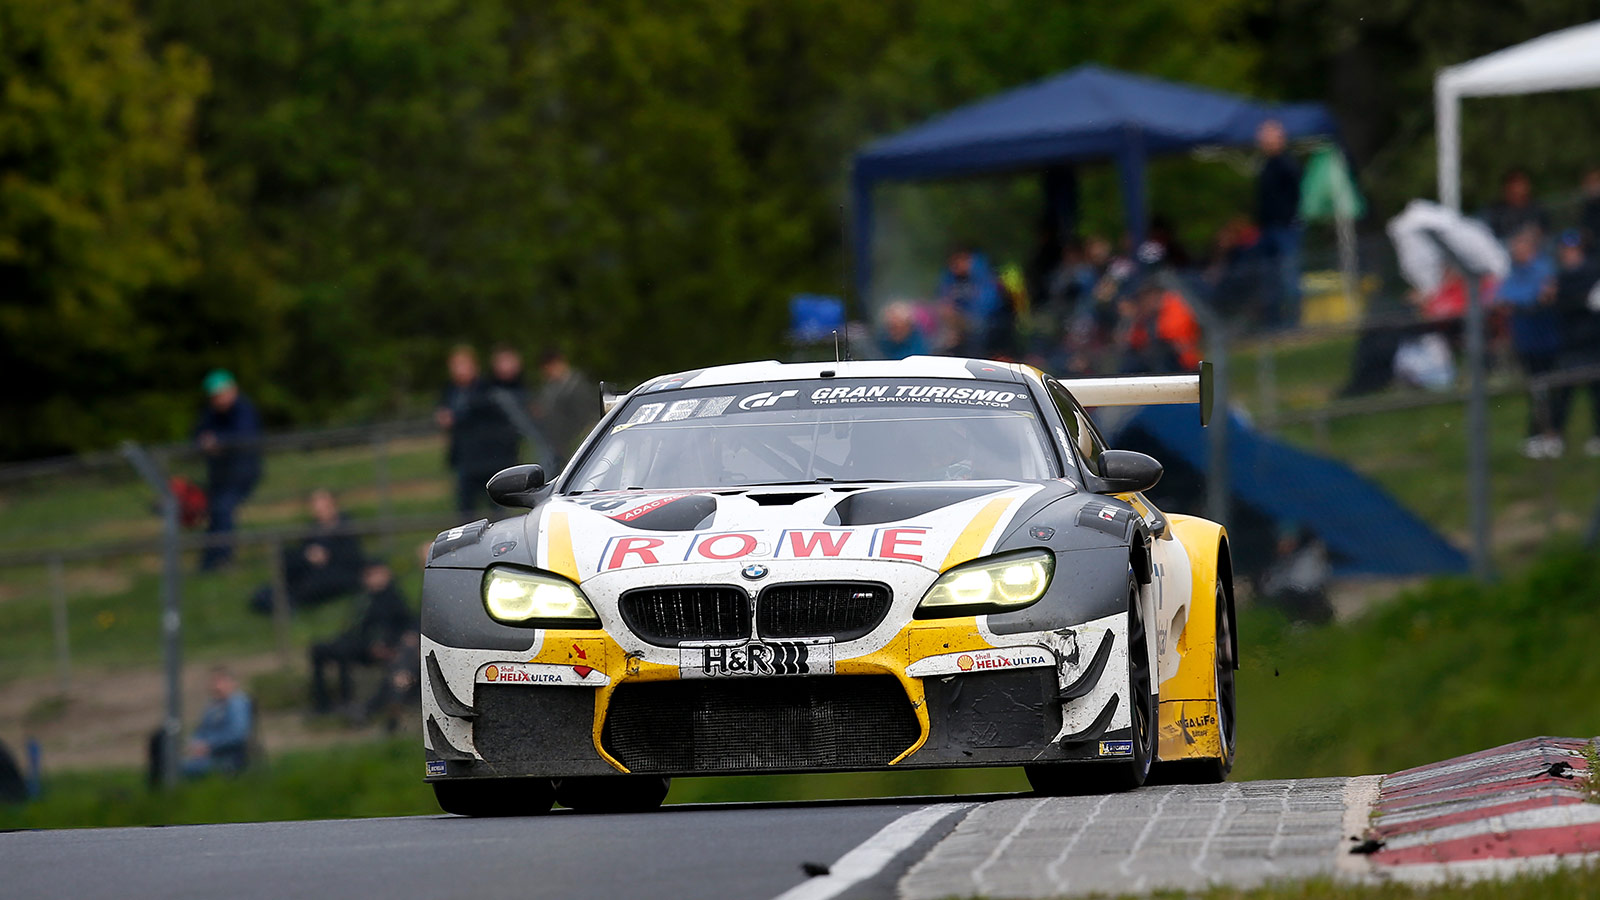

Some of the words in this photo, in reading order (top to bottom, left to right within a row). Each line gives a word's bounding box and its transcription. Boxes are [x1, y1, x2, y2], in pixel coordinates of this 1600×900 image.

[811, 385, 889, 399] GRAN
[929, 398, 1009, 408] SIMULATOR
[624, 500, 661, 521] ADAC
[608, 529, 926, 570] ROWE
[703, 643, 773, 677] H&R
[976, 657, 1012, 669] HELIX
[1013, 656, 1046, 666] ULTRA
[500, 671, 531, 682] HELIX
[531, 674, 563, 682] ULTRA
